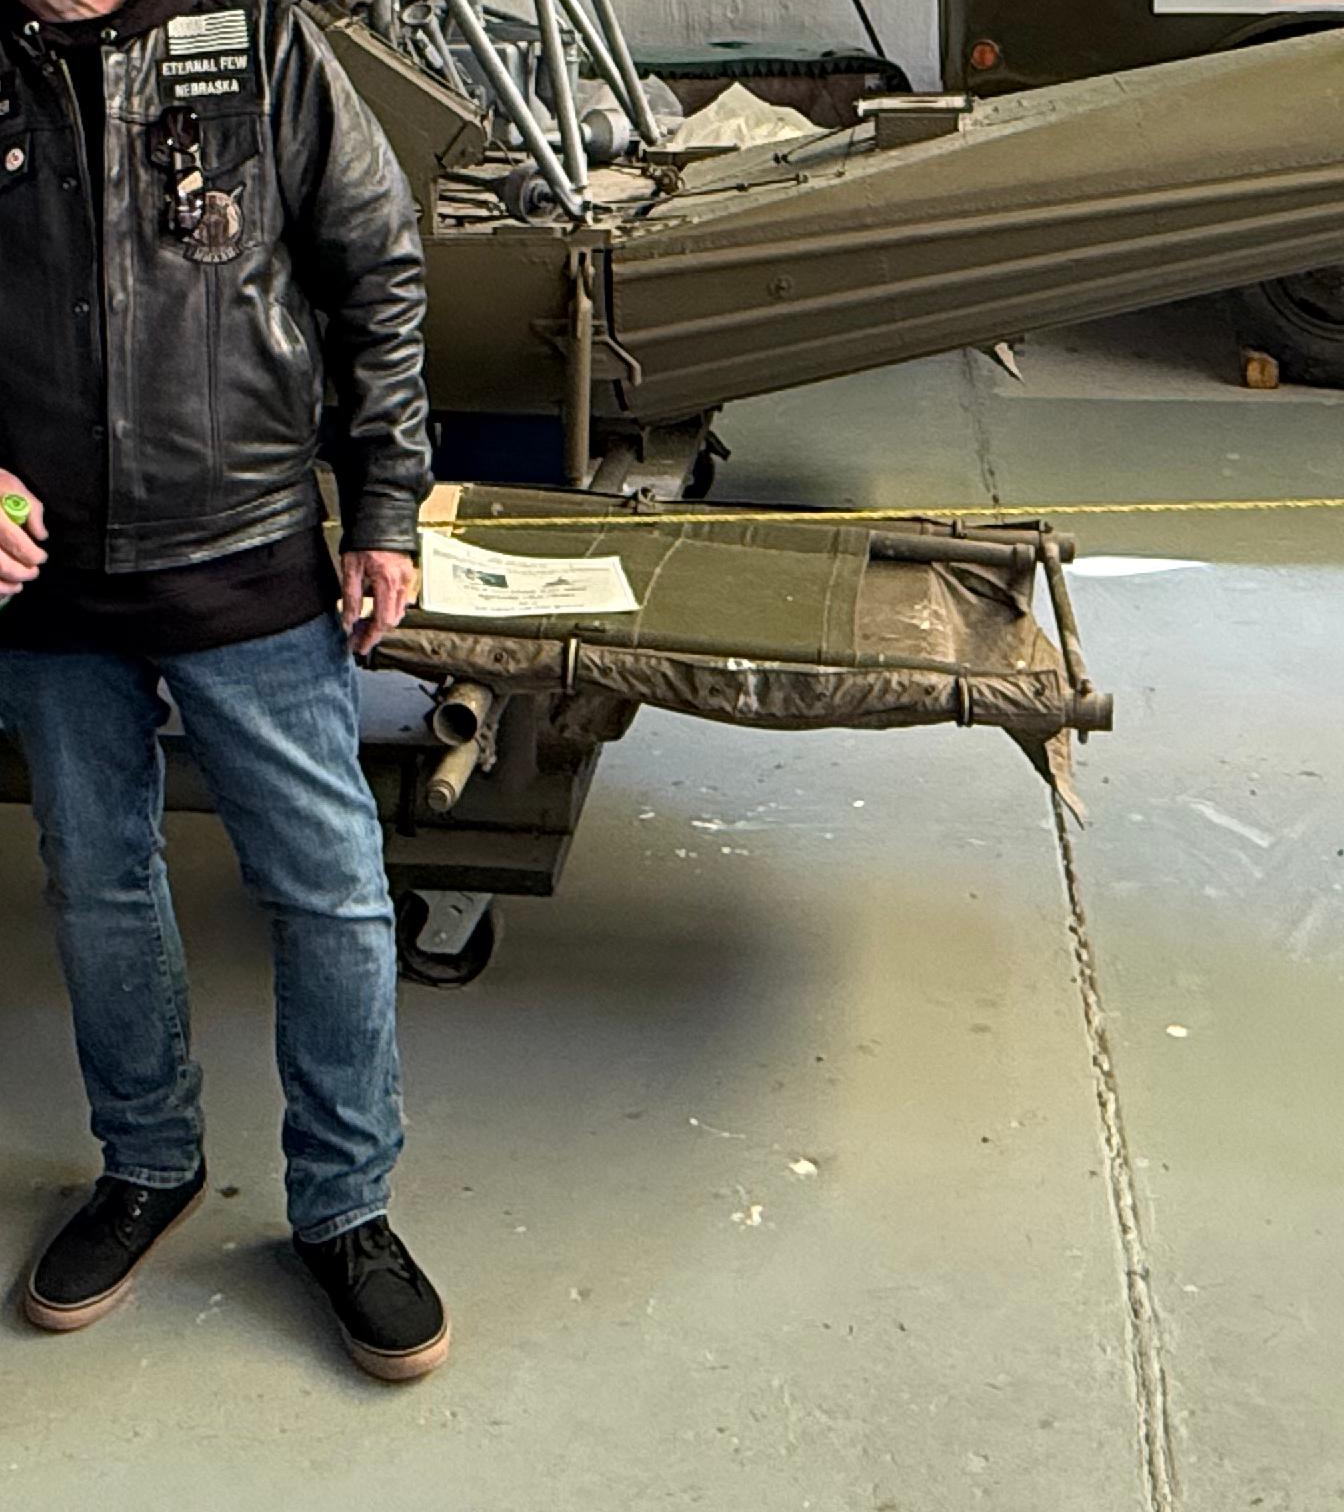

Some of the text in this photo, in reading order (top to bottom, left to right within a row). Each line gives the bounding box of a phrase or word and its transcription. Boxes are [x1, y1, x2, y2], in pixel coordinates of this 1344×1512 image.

[162, 55, 247, 76] ETERNAL FEW
[174, 78, 240, 98] NEBRASKA
